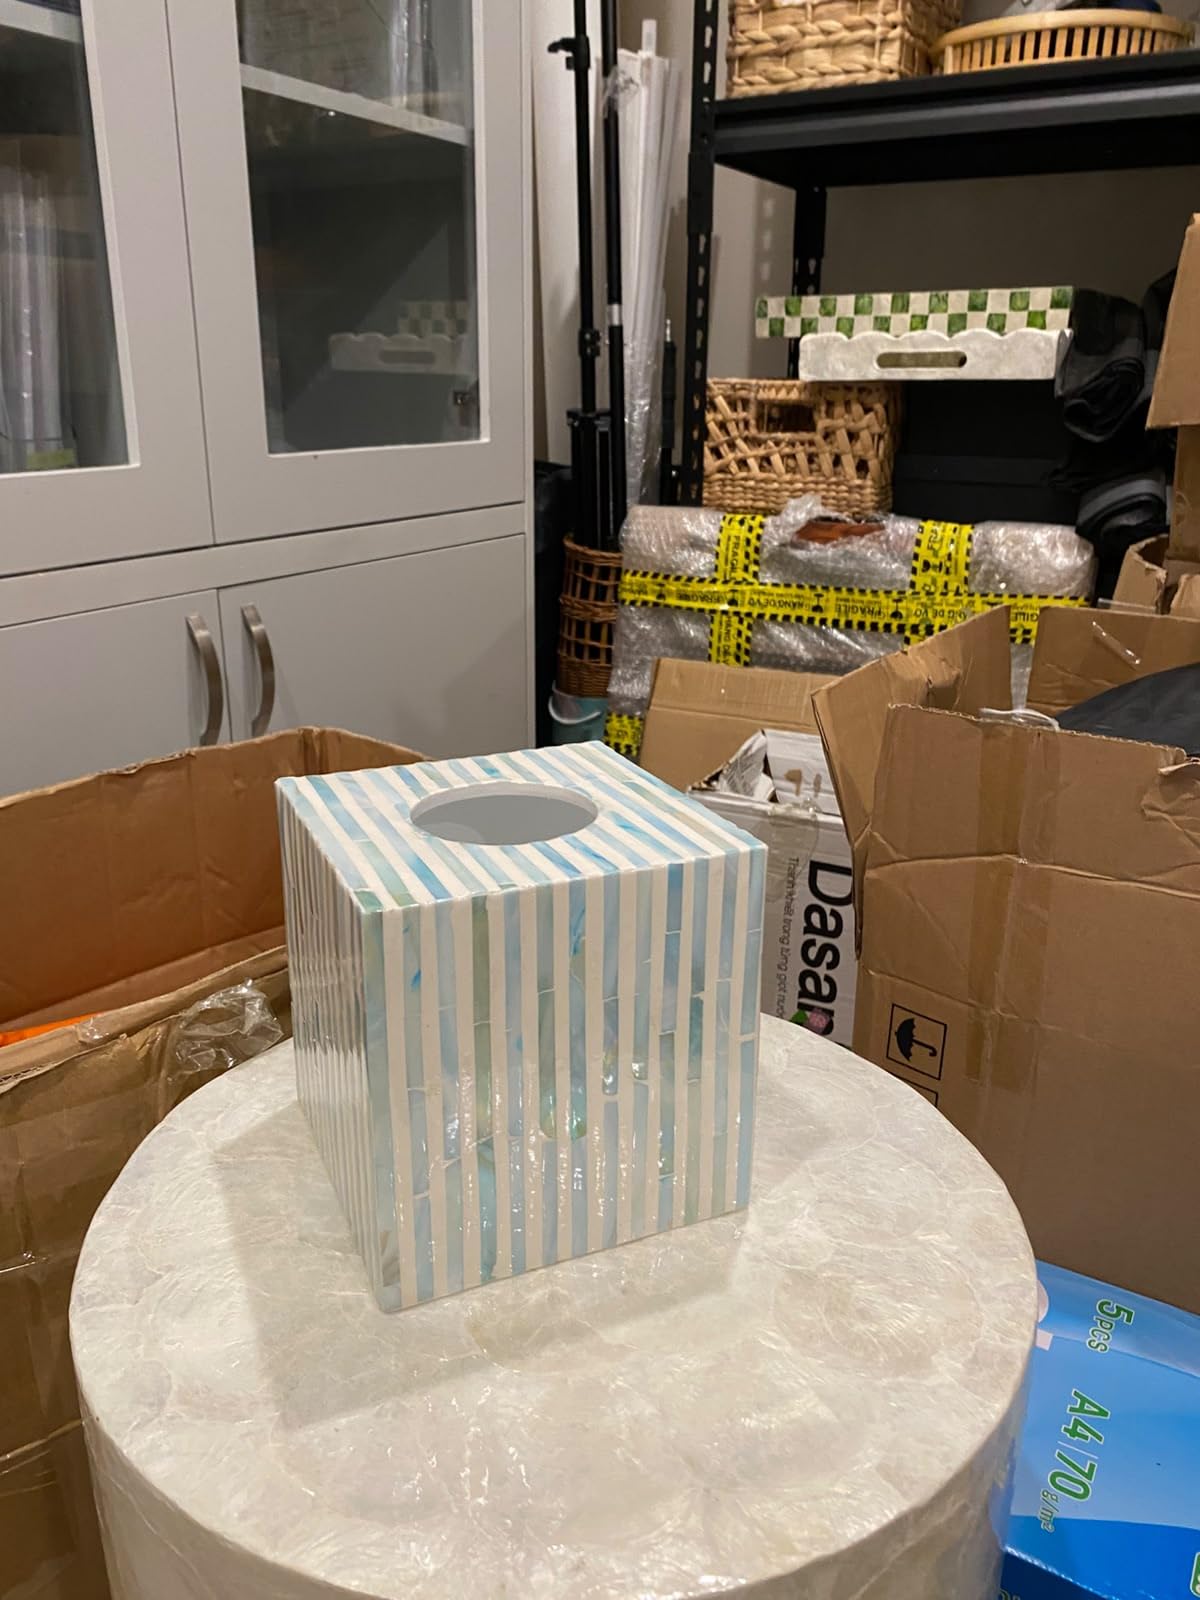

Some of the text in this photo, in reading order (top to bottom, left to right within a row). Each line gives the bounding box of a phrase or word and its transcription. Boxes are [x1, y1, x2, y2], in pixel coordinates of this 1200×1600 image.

[835, 604, 882, 616] FRAGILE
[779, 918, 793, 945] trong
[793, 860, 853, 1037] Dasan
